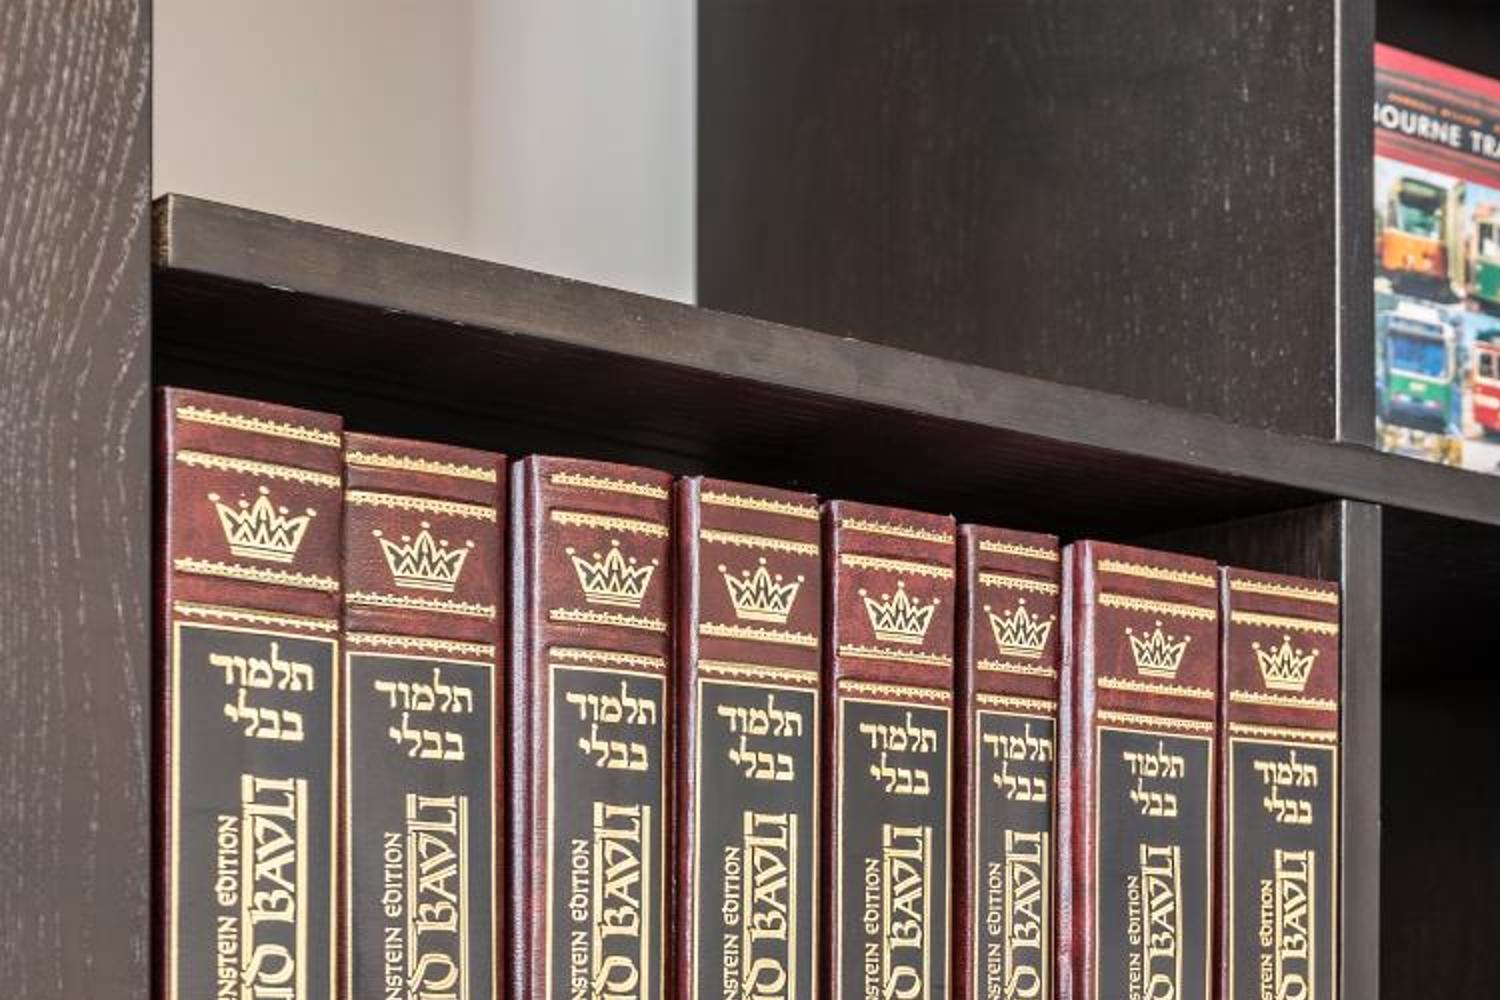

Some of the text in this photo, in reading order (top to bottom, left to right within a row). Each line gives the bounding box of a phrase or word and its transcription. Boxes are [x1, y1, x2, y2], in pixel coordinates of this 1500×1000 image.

[209, 642, 314, 692] תלמוד
[375, 668, 473, 713] תלמוד
[566, 682, 656, 725] תלמוד
[224, 690, 305, 741] בבלי
[388, 713, 465, 761] בבלי
[718, 695, 802, 737] תלמוד
[860, 712, 936, 753] תלמוד
[577, 724, 649, 771] בבלי
[729, 737, 794, 781] בבלי
[984, 724, 1053, 762] תלמוד
[1124, 741, 1185, 778] תלמוד
[870, 753, 929, 795] בבלי
[993, 763, 1047, 801] בבלי
[1254, 749, 1317, 787] תלמוד
[1129, 780, 1177, 818] בבלי
[1263, 787, 1312, 824] בבלי
[242, 778, 295, 923] BAVLI
[407, 795, 459, 933] BAVLI
[594, 804, 641, 937] BAVLI
[745, 812, 787, 942] BAVLI
[883, 824, 925, 946] BAVLI
[1007, 829, 1041, 949] BAVLI
[1142, 845, 1175, 958] BAVLI
[1277, 850, 1308, 960] BAVLI
